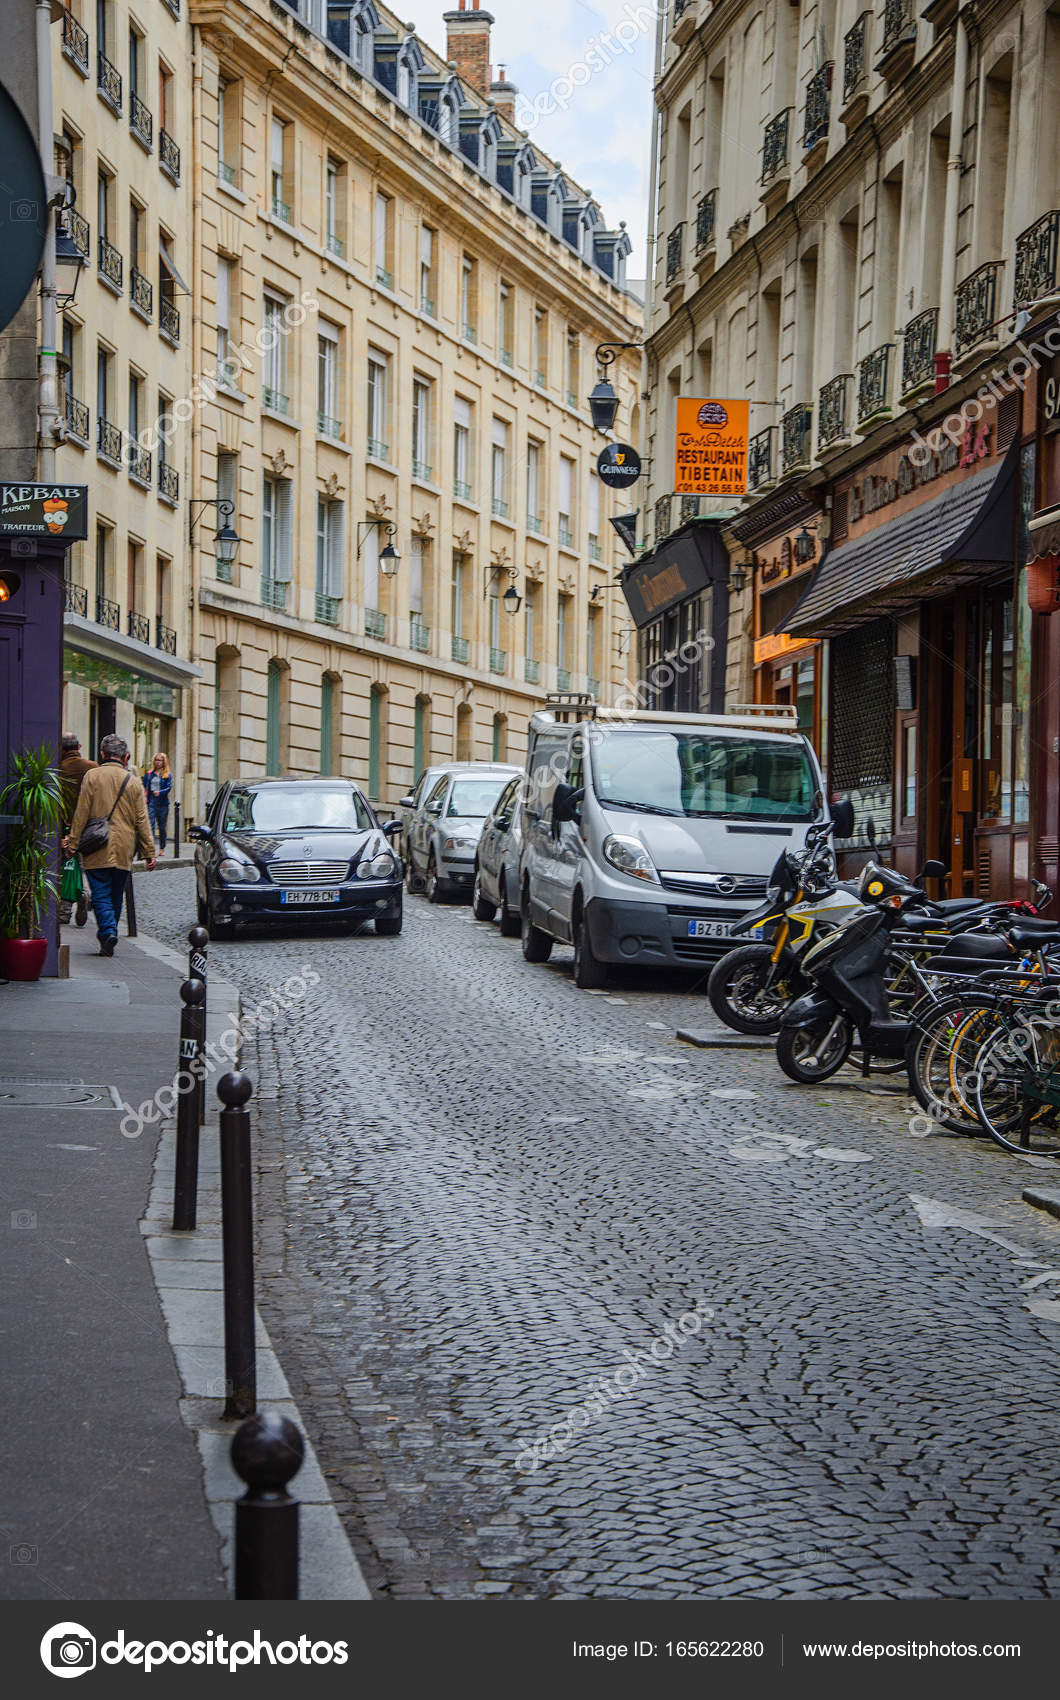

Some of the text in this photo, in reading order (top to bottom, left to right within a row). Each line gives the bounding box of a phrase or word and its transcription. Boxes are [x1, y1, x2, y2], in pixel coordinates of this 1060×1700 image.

[677, 450, 745, 465] RESTAURANT
[680, 467, 743, 481] TIBETAIN
[696, 484, 707, 492] 43
[708, 484, 719, 492] 26
[1, 486, 81, 506] KEBAB
[1, 504, 30, 514] MAISON
[1, 523, 45, 532] TRAITEUR
